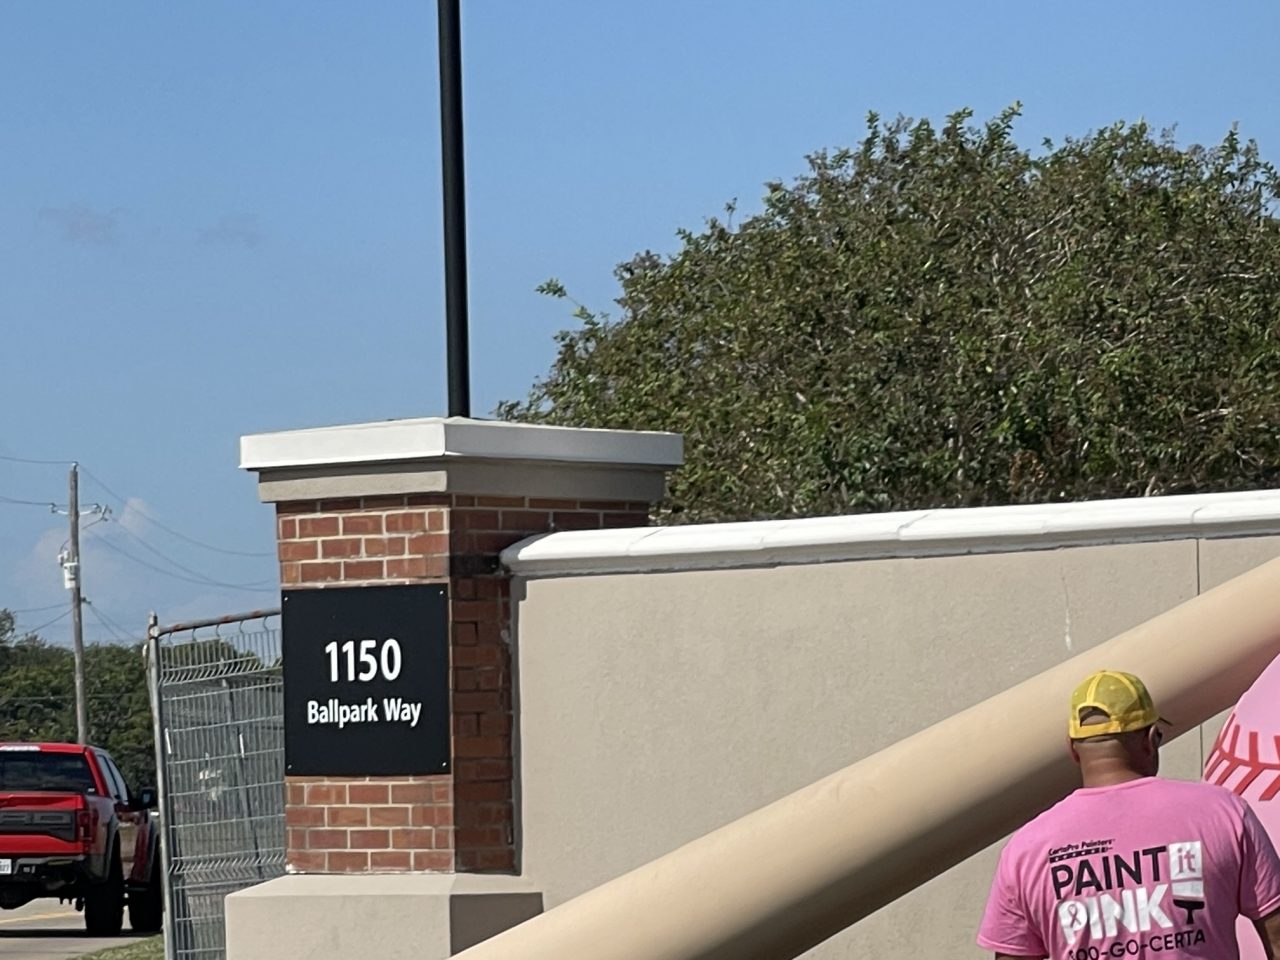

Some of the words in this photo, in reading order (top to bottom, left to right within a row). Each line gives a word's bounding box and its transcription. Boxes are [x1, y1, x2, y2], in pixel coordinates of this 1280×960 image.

[325, 638, 401, 682] 1150
[307, 698, 379, 728] Ballpark
[384, 698, 421, 727] Way
[1051, 846, 1167, 900] PAINT
[1177, 847, 1196, 874] it
[1058, 884, 1173, 945] PINK
